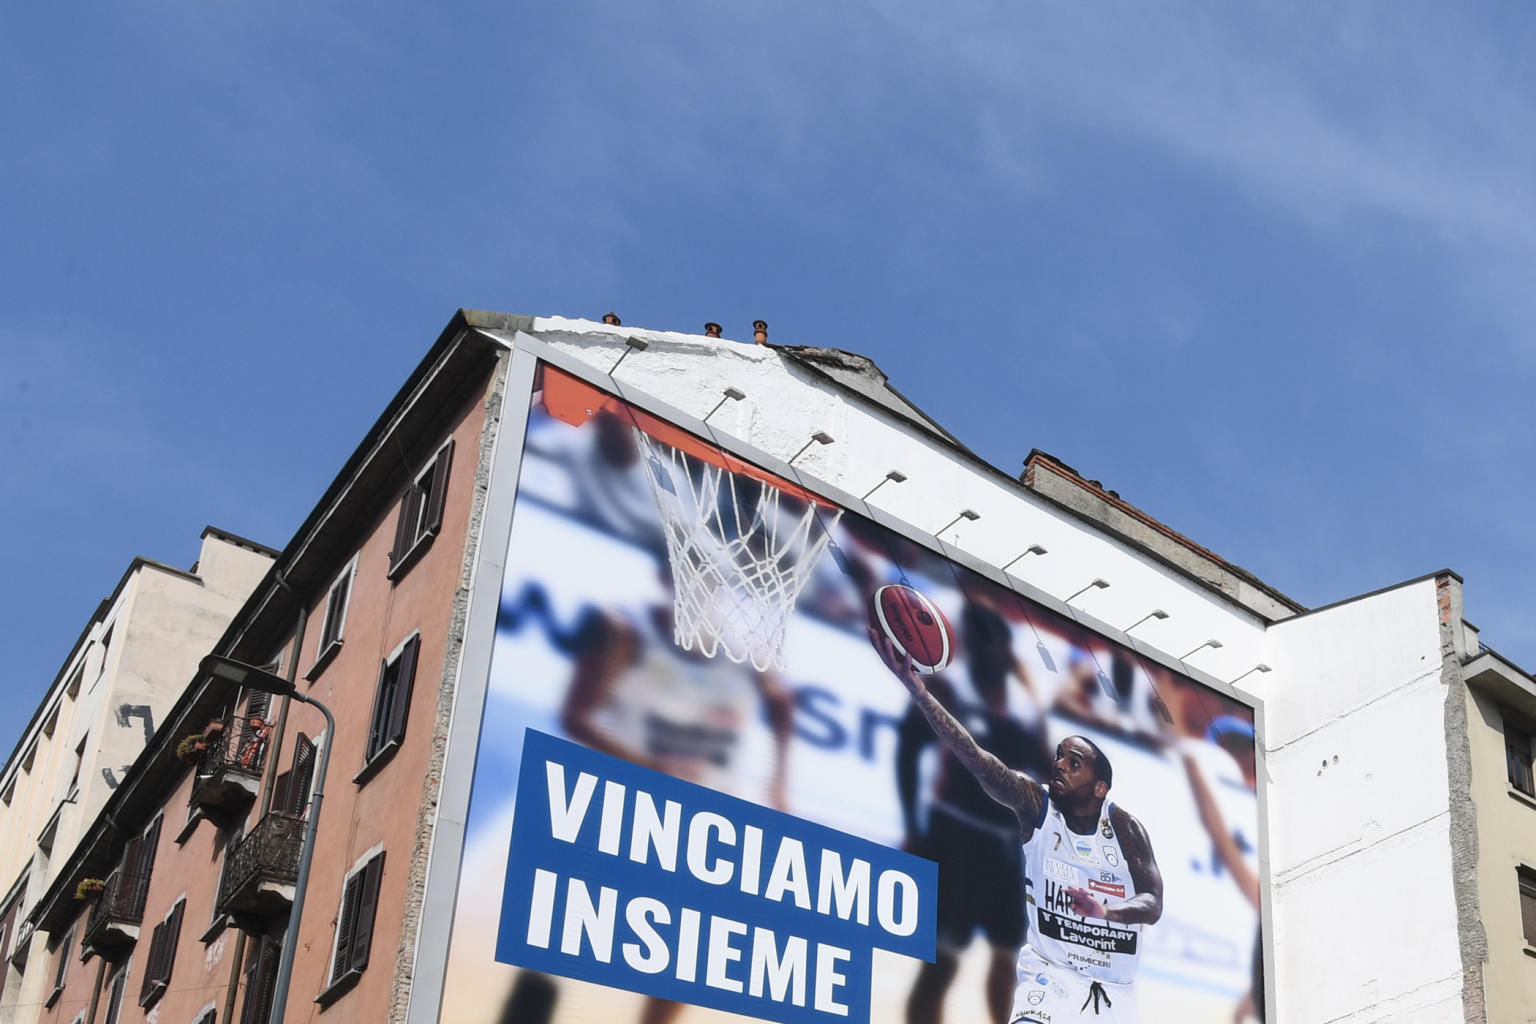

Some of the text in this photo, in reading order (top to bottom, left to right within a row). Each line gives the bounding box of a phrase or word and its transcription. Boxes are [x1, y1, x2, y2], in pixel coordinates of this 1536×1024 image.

[546, 760, 919, 937] VINCIAMO
[1053, 831, 1062, 851] 7
[1055, 916, 1134, 941] TEMPORARY
[1060, 927, 1117, 951] Lavorint
[526, 868, 851, 1017] INSIEME
[1067, 952, 1111, 968] PRIMICERI
